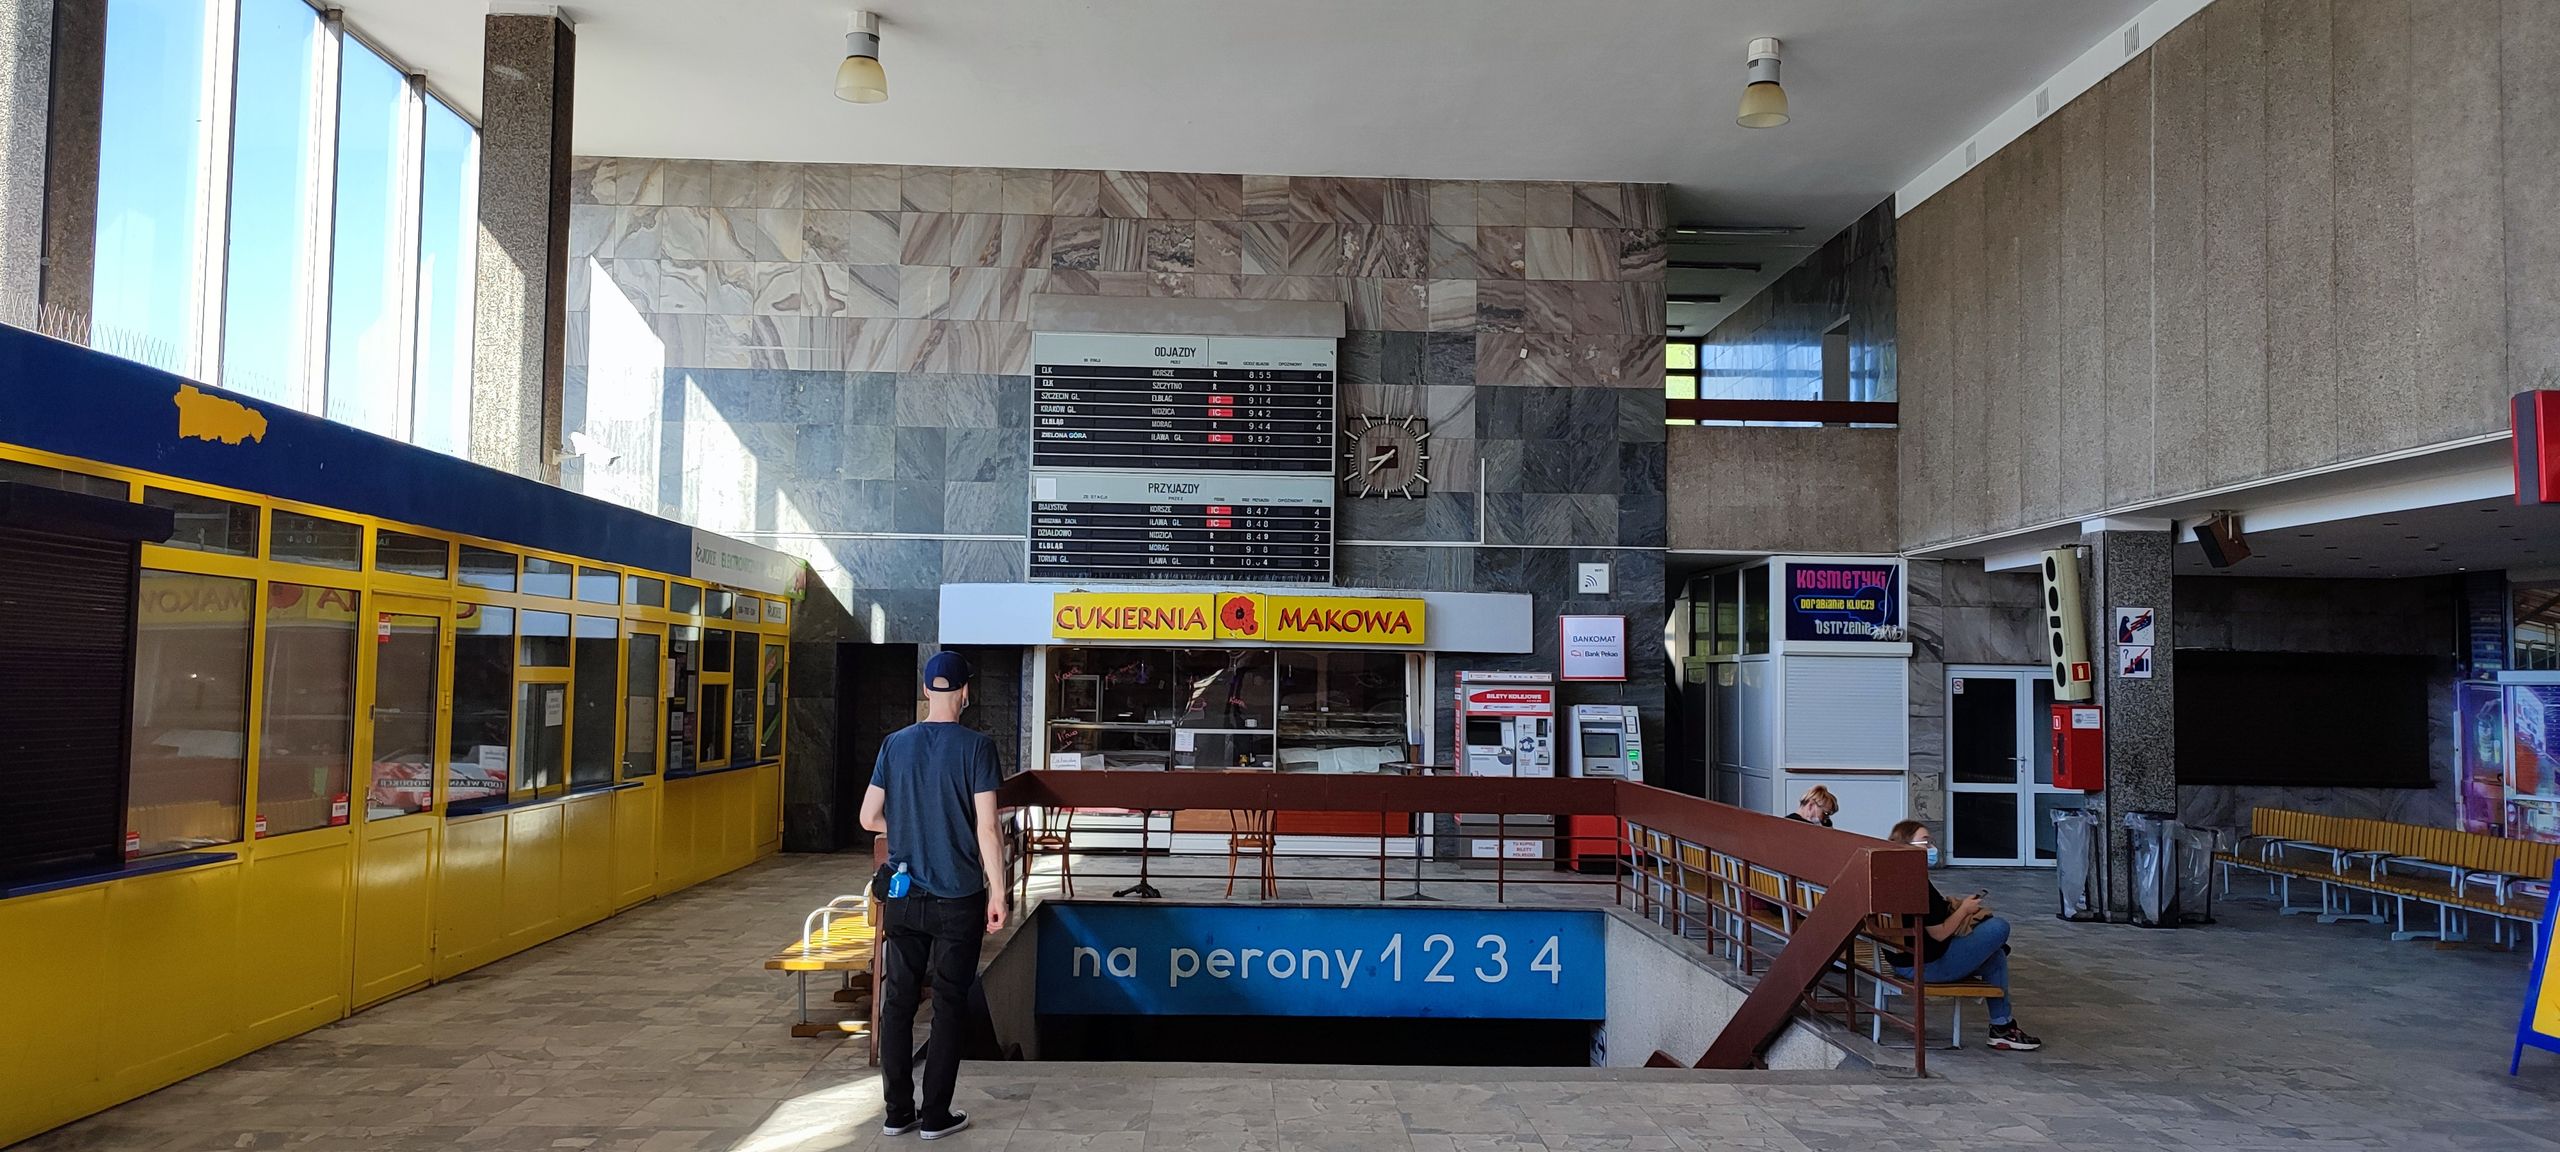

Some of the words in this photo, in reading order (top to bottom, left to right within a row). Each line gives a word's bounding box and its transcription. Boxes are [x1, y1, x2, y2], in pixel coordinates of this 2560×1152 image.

[1154, 346, 1196, 358] ODJAZDY
[1248, 371, 1271, 379] 8.55
[1152, 382, 1182, 390] SZCZYTNO
[1248, 384, 1271, 392] 9.13
[1041, 392, 1068, 400] SZCZECIN
[1212, 396, 1221, 404] IC
[1248, 396, 1271, 404] 9.14
[1248, 409, 1271, 418] 9.42
[1316, 410, 1322, 418] 2
[1213, 421, 1217, 429] R
[1248, 422, 1271, 430] 9.44
[1212, 434, 1221, 442] IC
[1248, 435, 1270, 443] 9.52
[1316, 436, 1321, 444] 3
[1148, 482, 1200, 494] PRZYJAZDY
[1210, 506, 1219, 514] IC
[1246, 507, 1269, 515] 8.47
[1314, 508, 1320, 516] 4
[1210, 519, 1219, 527] IC
[1314, 521, 1320, 529] 2
[1314, 534, 1320, 542] 2
[1056, 606, 1208, 630] CUKIERNIA
[1278, 608, 1412, 634] MAKOWA
[1073, 945, 1137, 978] na
[1169, 946, 1363, 989] perony
[1379, 932, 1402, 982] 1
[1422, 934, 1455, 984] 2
[1475, 934, 1509, 985] 3
[1530, 935, 1562, 985] 4
